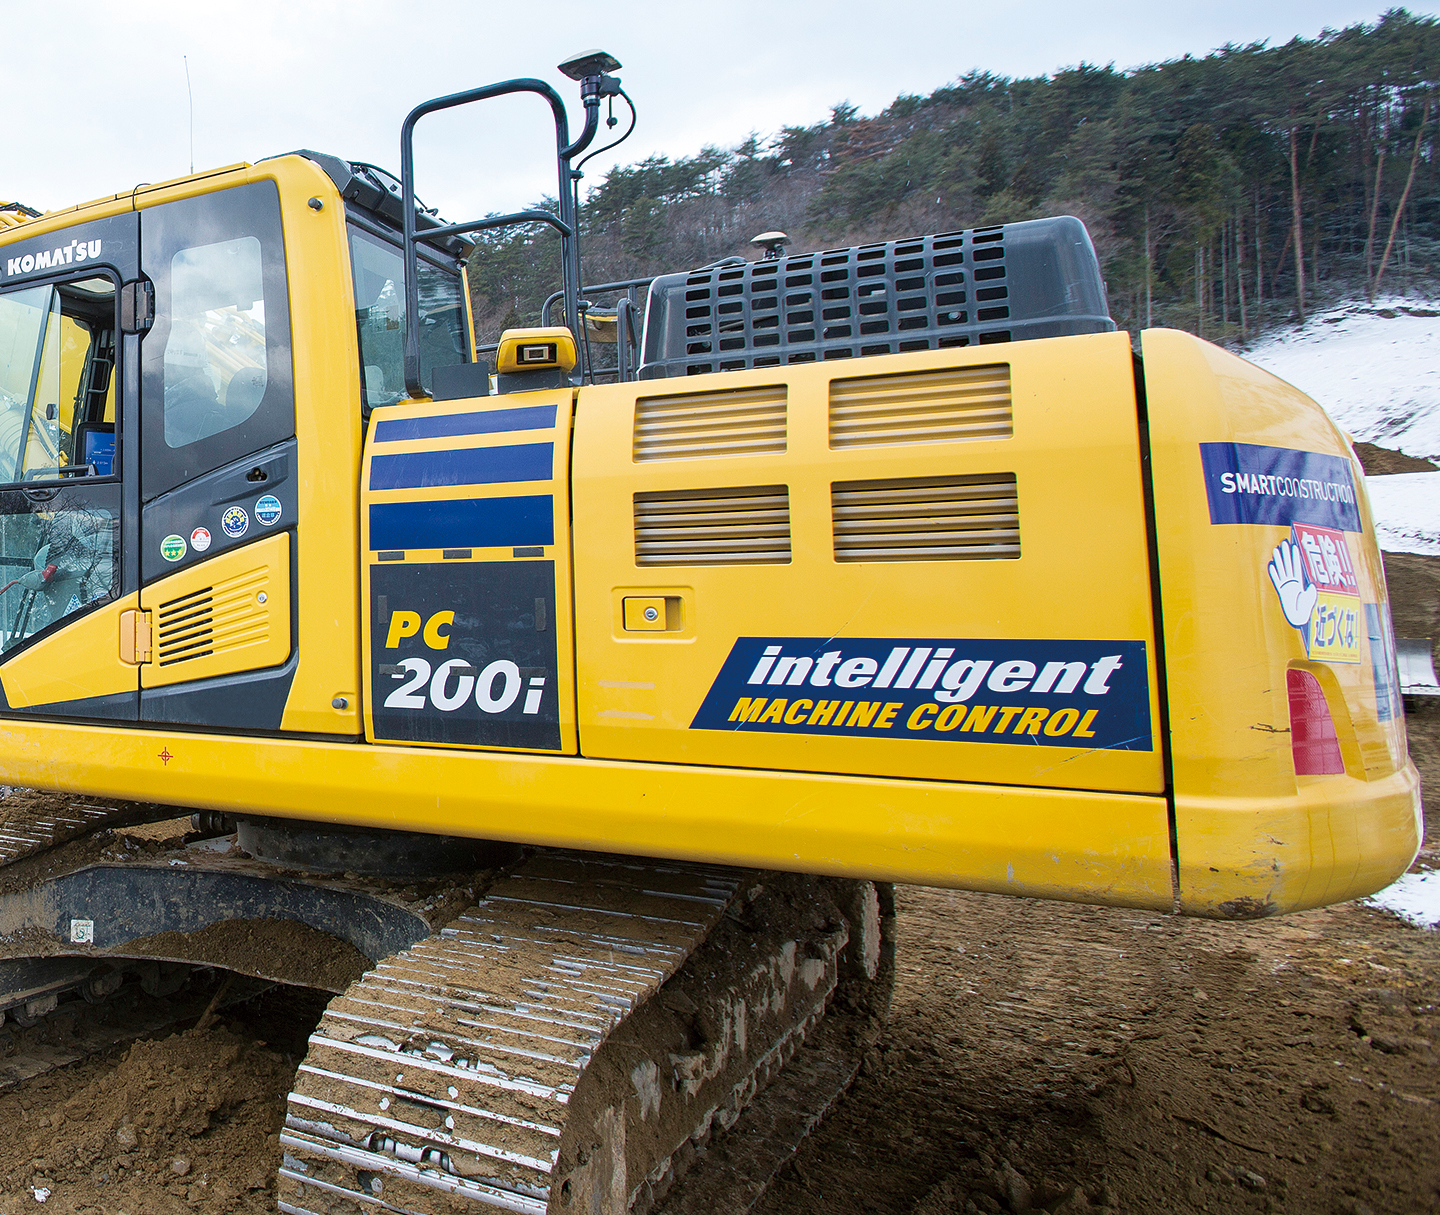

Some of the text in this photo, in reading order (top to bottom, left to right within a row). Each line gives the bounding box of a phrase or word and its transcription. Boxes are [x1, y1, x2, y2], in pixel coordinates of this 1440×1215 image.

[7, 239, 102, 276] KOMATSU
[385, 610, 456, 650] PC
[383, 657, 546, 714] 200i
[746, 645, 1123, 703] intelligent
[727, 697, 1099, 738] MACHINE CONTROL
